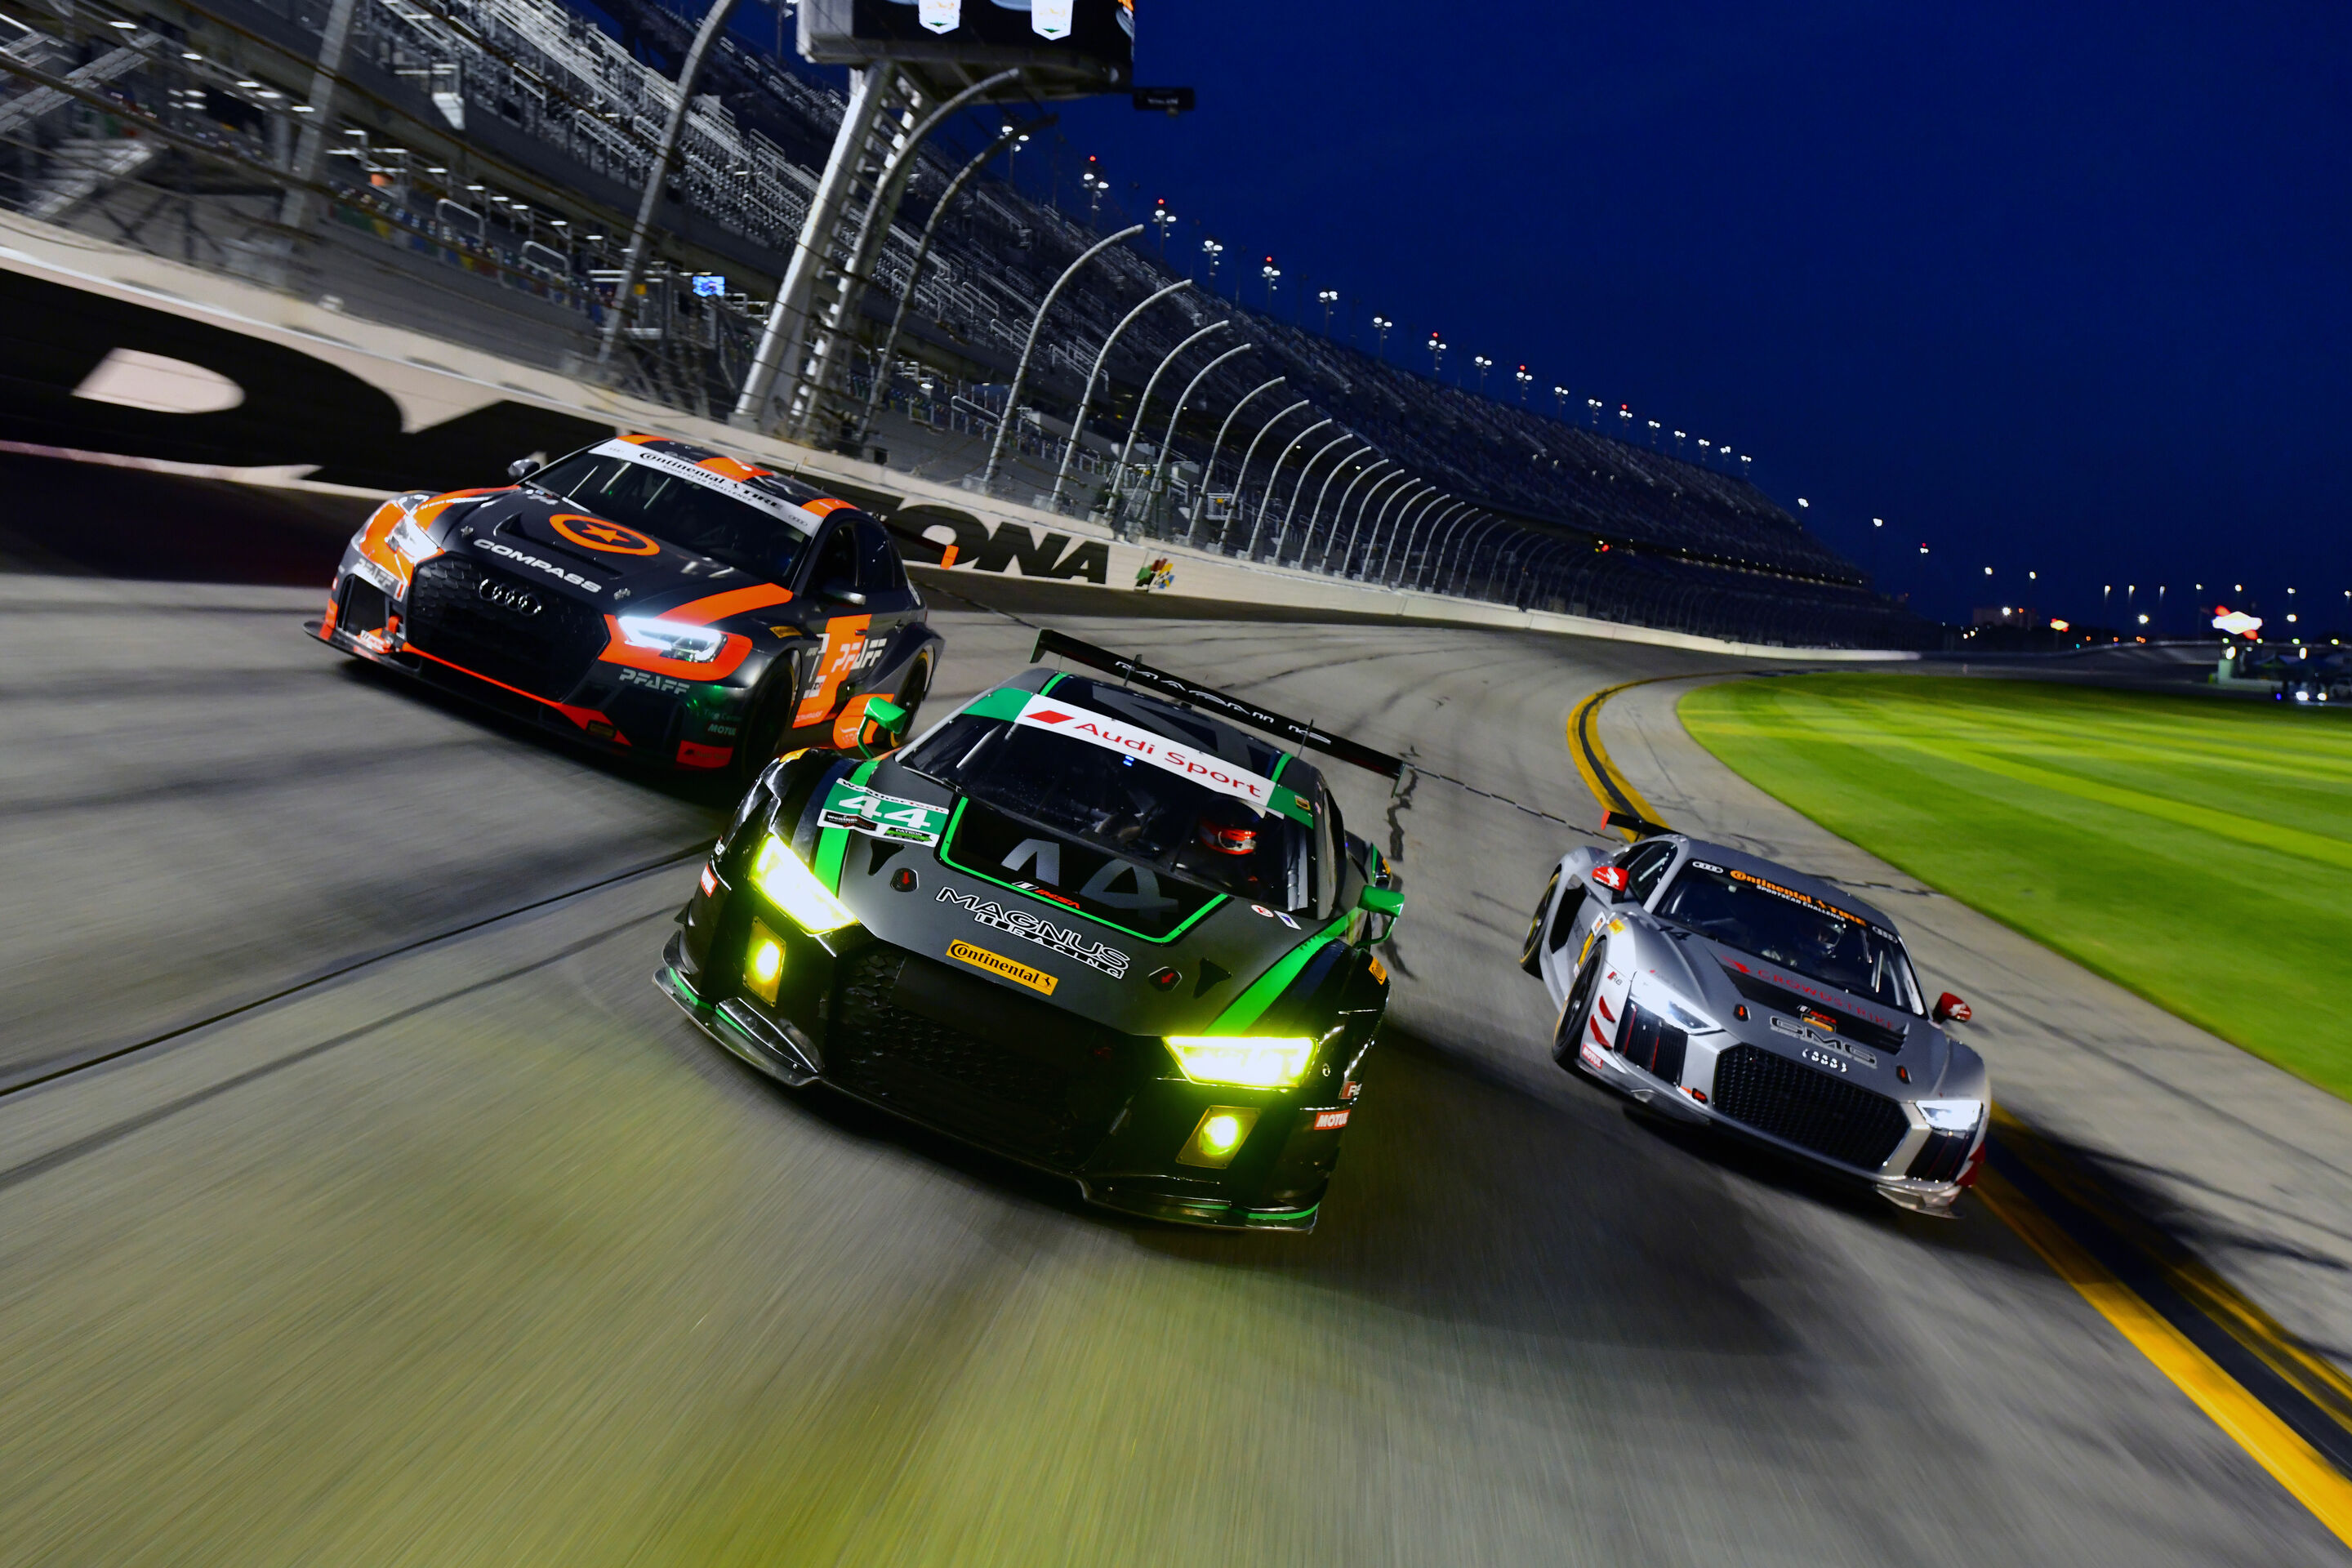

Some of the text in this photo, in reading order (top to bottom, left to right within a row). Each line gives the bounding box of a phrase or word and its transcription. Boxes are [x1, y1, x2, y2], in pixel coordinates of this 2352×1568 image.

[639, 452, 725, 484] Continental
[737, 485, 783, 512] TIRE
[473, 537, 603, 593] COMPASS
[618, 668, 691, 695] PFAFF
[1073, 722, 1262, 799] Audi Sport
[838, 795, 932, 830] 44
[1730, 869, 1812, 904] Continental
[935, 886, 1130, 970] MAGNUS
[1009, 925, 1125, 979] RACING
[949, 941, 1040, 985] Continental
[1757, 969, 1895, 1030] CROWDSTRIKE
